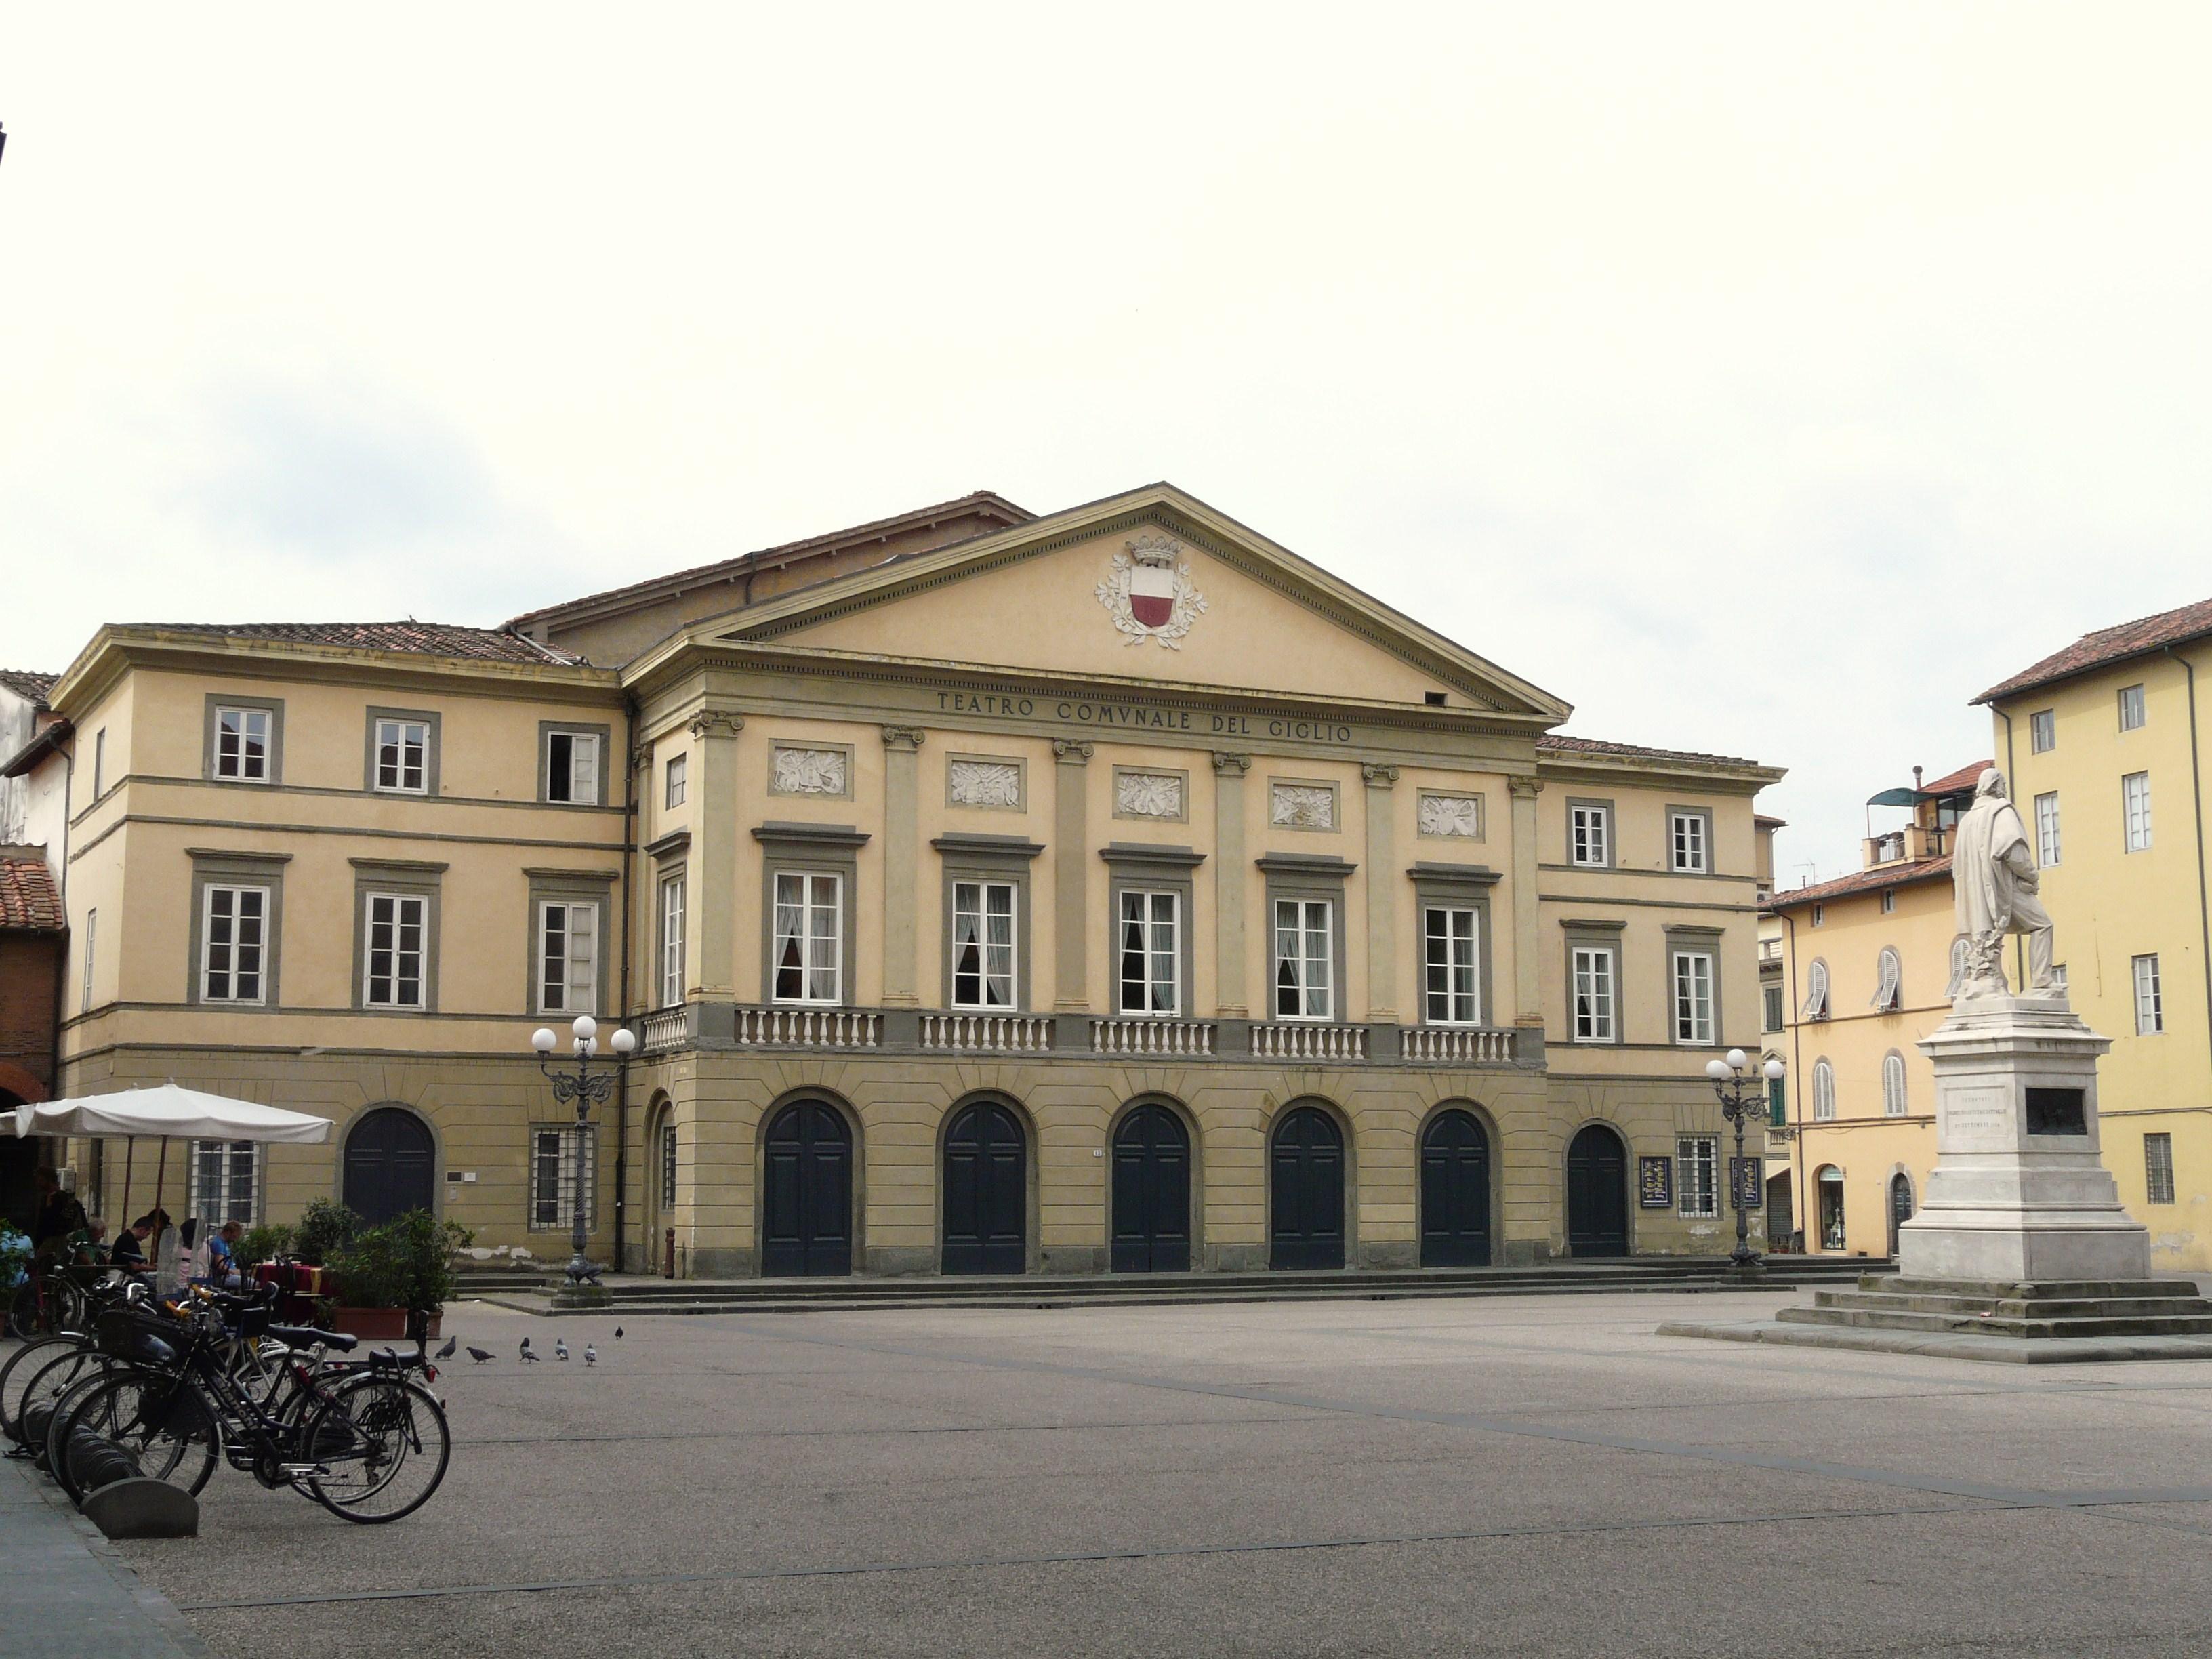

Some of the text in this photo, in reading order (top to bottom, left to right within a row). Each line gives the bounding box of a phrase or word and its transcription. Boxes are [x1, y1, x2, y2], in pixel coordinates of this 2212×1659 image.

[937, 693, 1351, 742] TEATRO COMVNALE DEL GIGLIO
